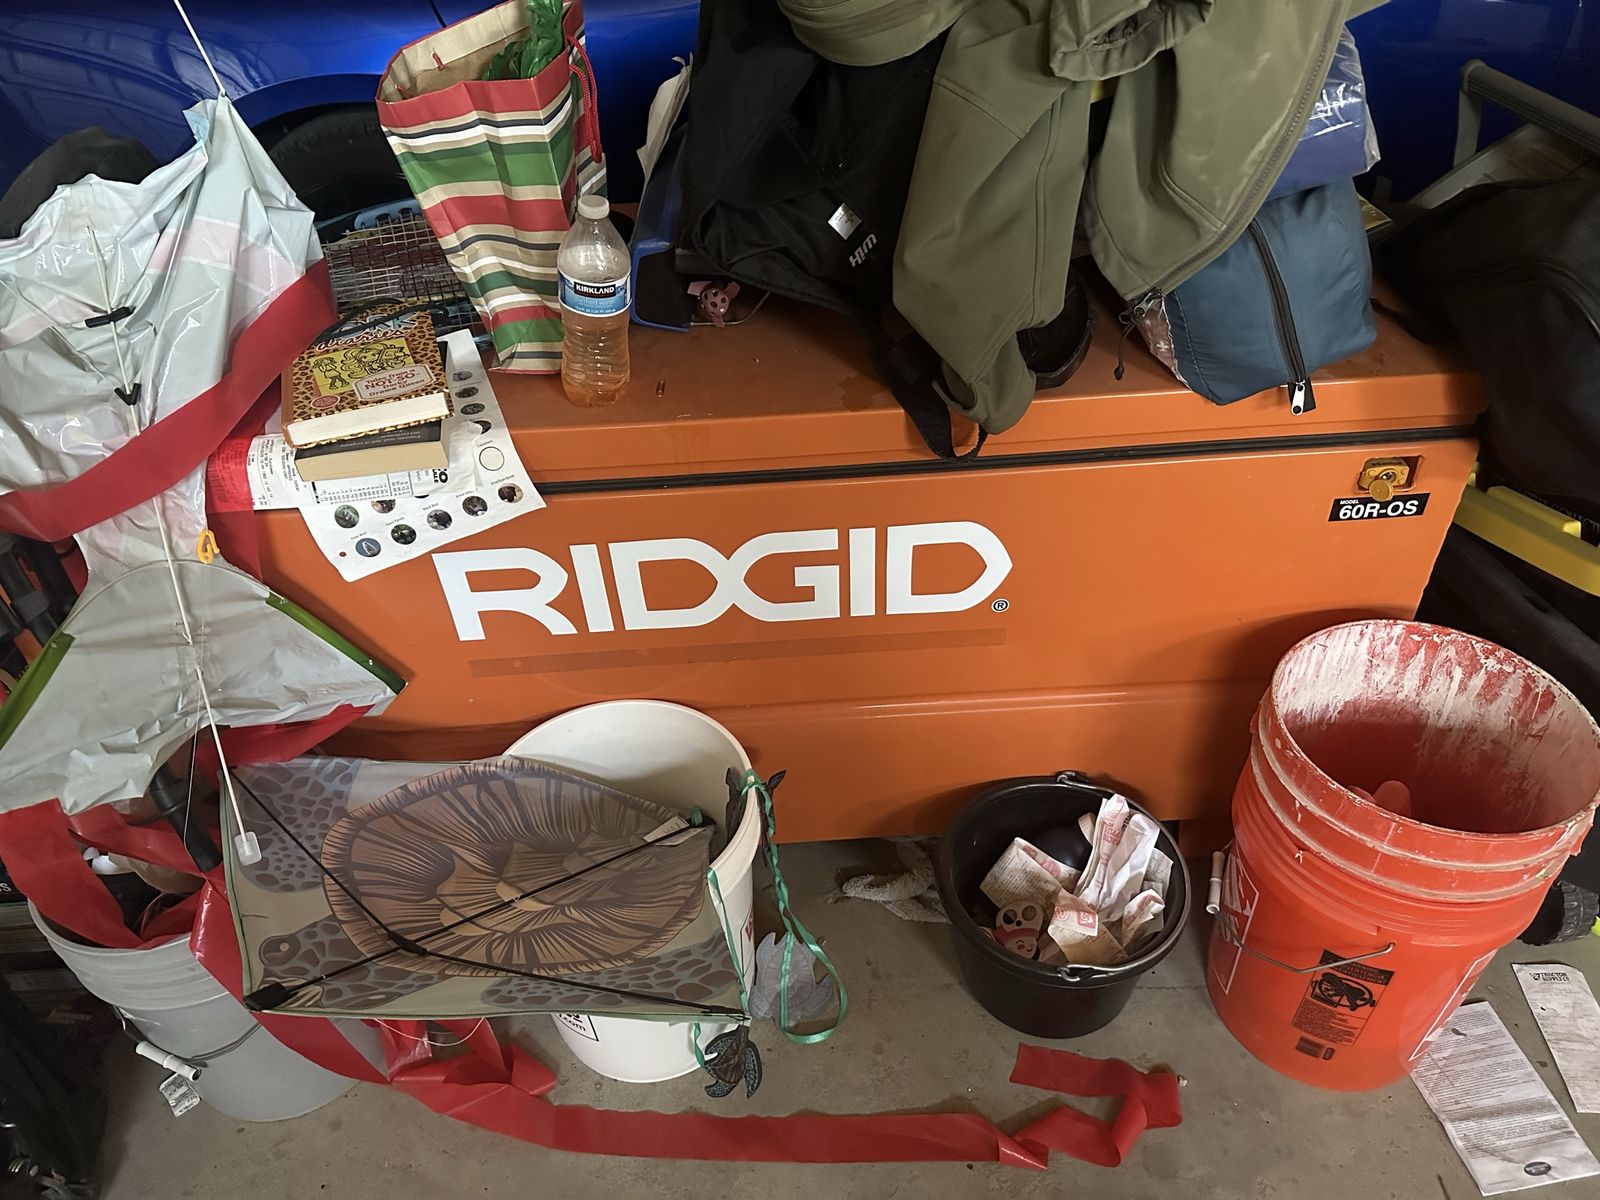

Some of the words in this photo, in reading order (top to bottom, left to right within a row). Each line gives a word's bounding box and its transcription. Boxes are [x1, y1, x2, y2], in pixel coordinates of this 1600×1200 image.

[575, 284, 615, 294] KIRKLAND
[316, 328, 411, 351] diaries
[366, 376, 387, 384] Tales
[388, 370, 408, 378] from
[369, 387, 397, 396] Drama
[1339, 500, 1419, 520] 60R-OS
[432, 521, 1014, 642] RIDGID
